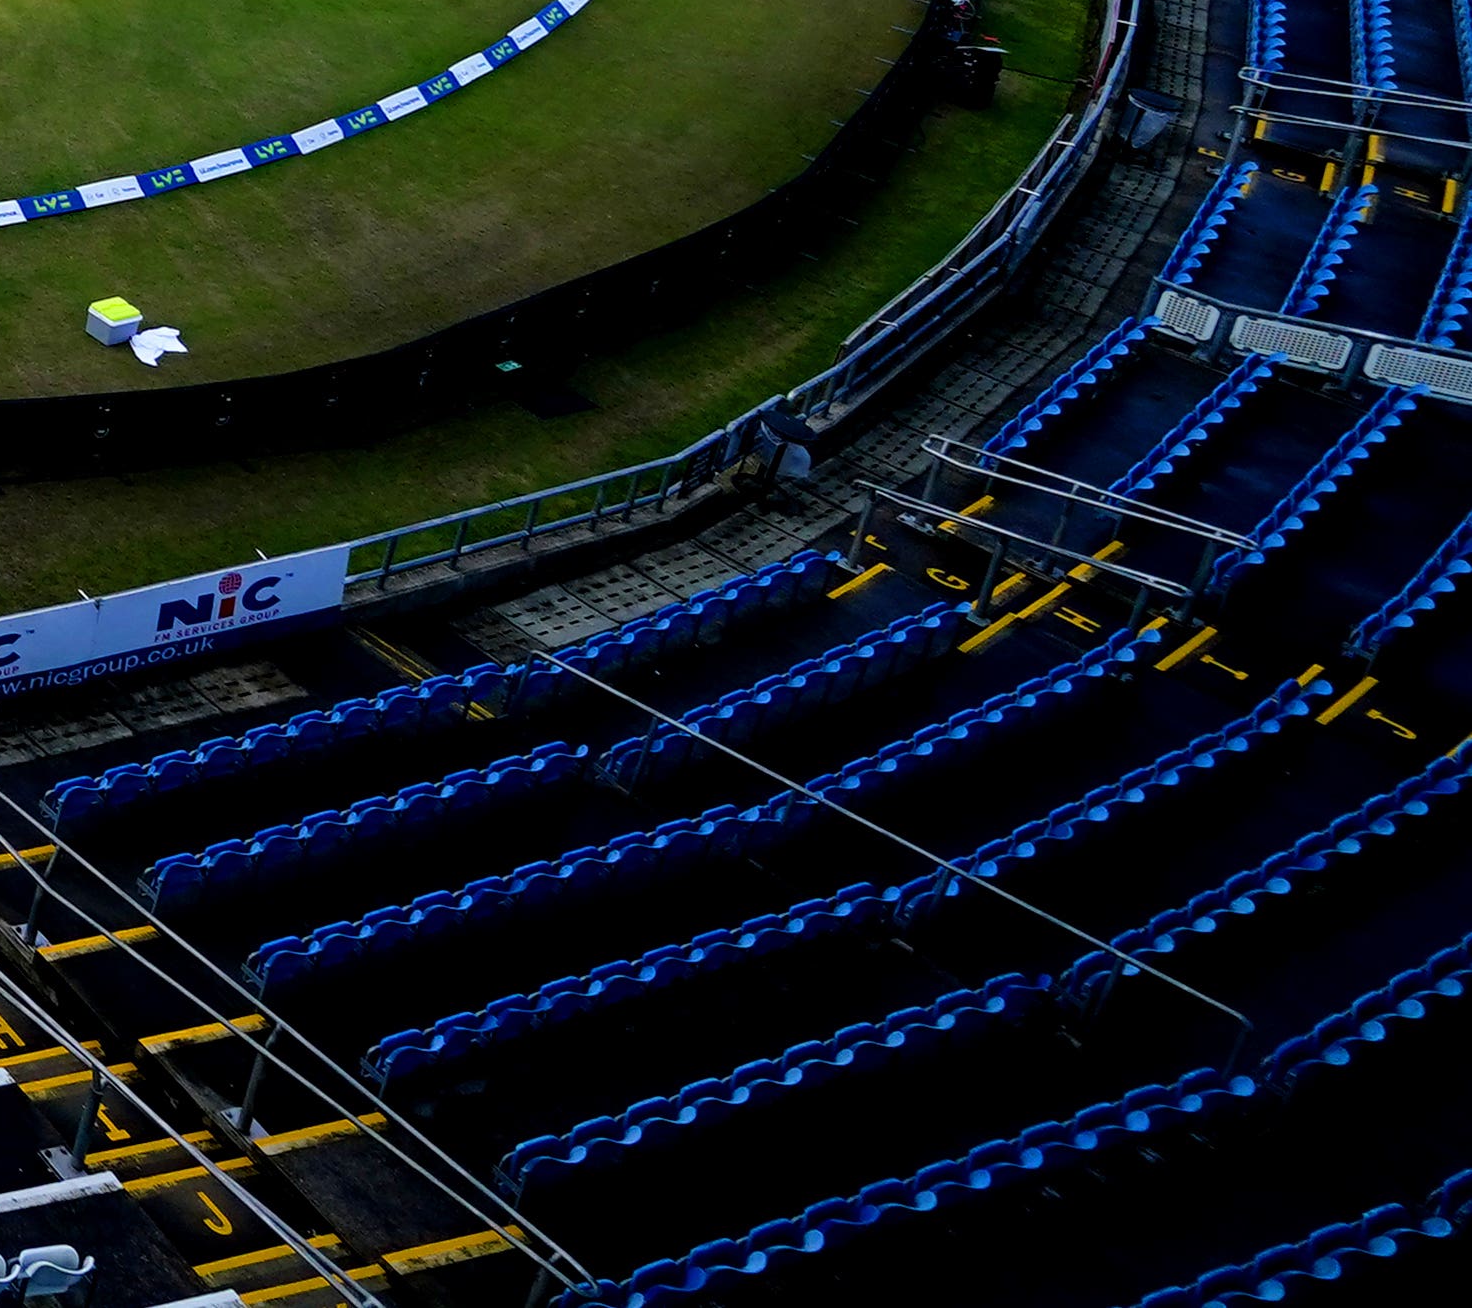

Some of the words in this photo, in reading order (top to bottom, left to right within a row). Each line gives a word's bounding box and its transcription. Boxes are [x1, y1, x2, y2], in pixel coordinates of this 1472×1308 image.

[176, 621, 236, 640] SERVICES
[240, 608, 281, 626] GROUP
[197, 1190, 234, 1236] J
